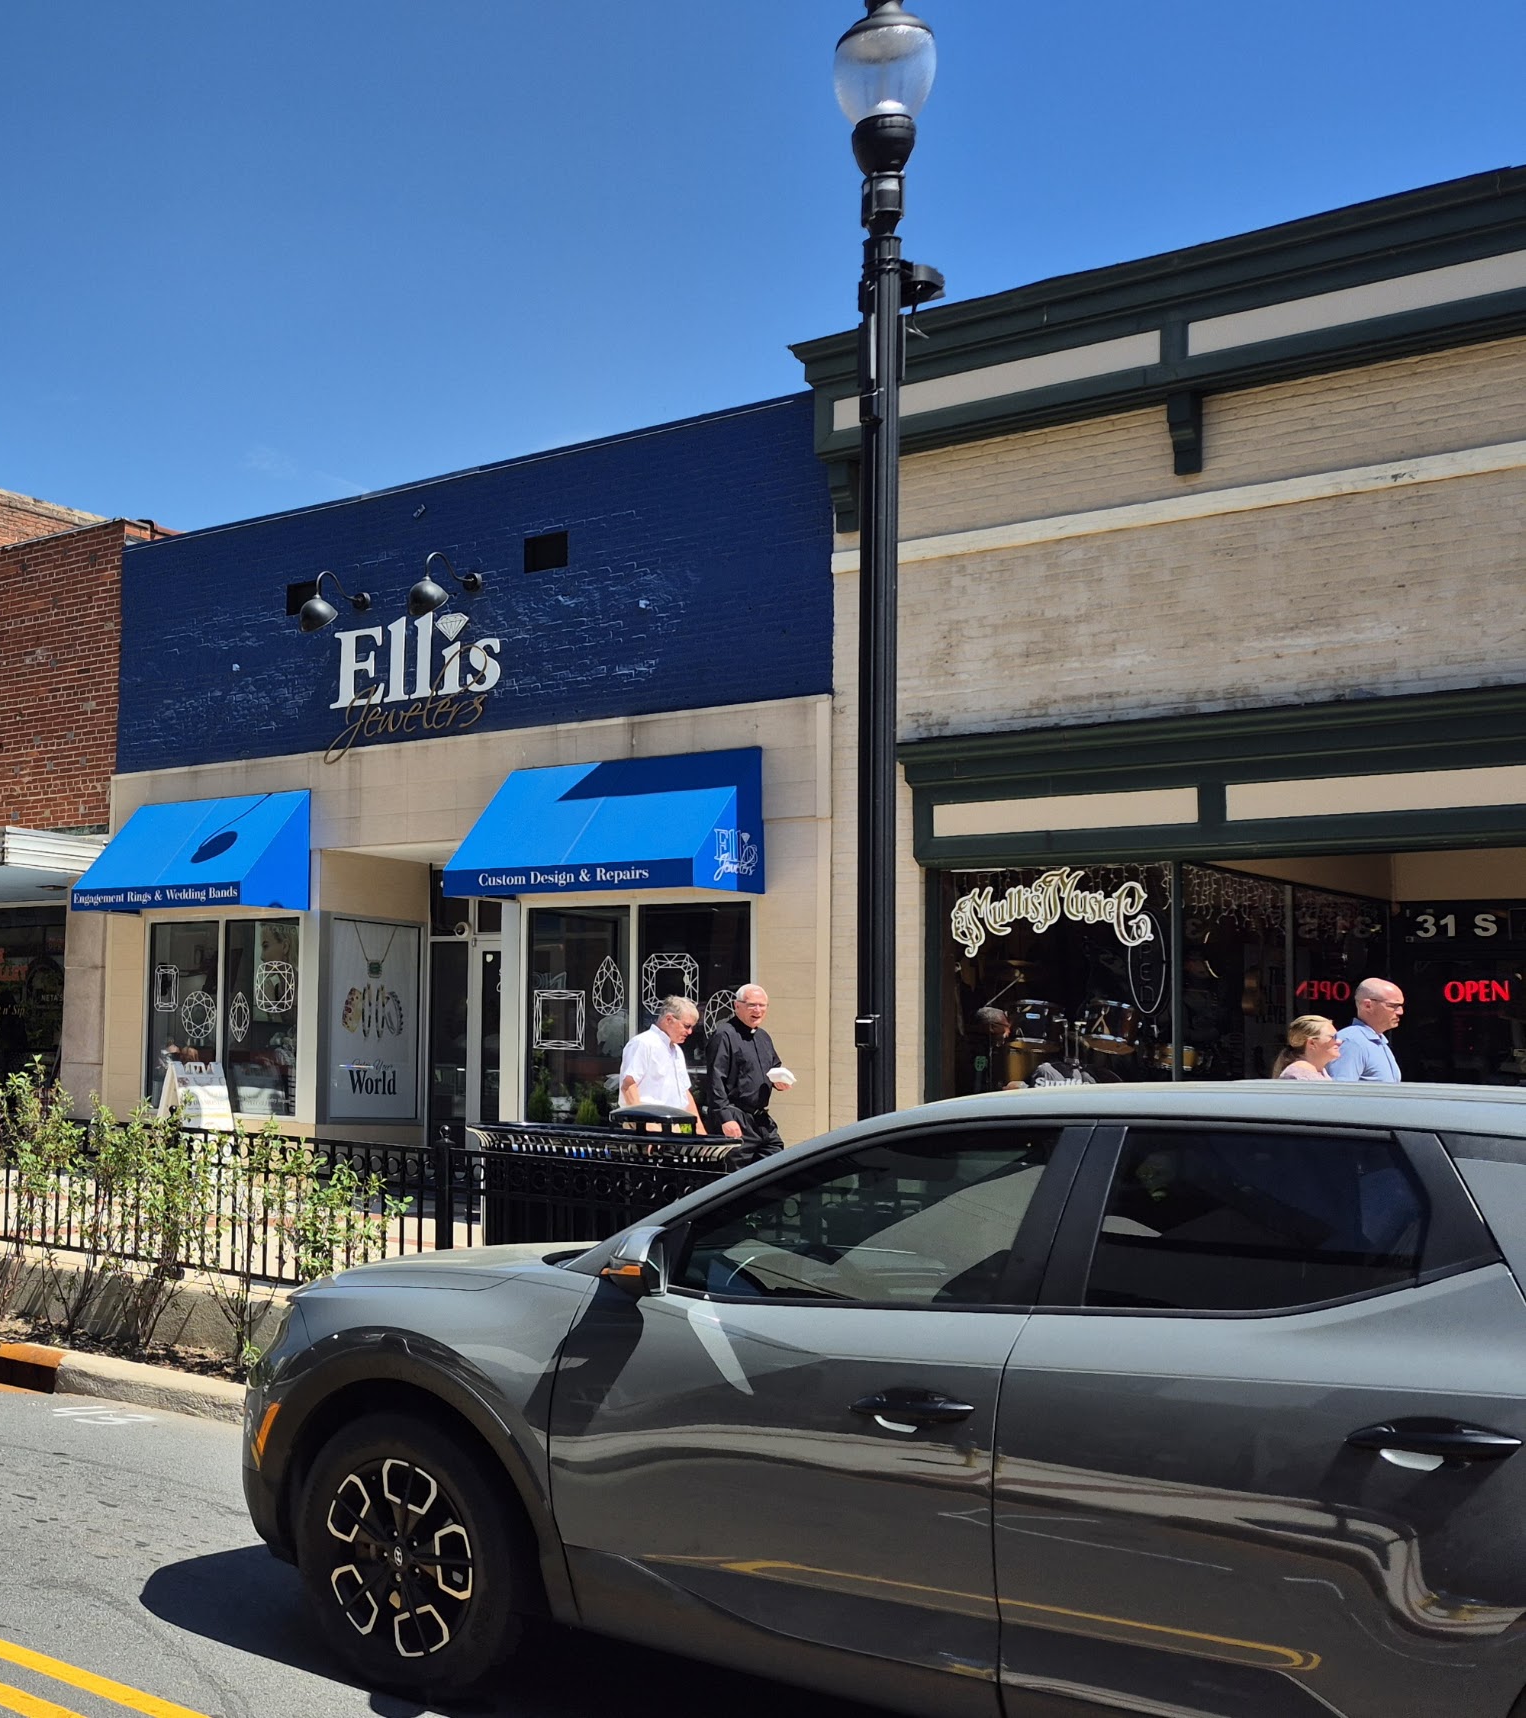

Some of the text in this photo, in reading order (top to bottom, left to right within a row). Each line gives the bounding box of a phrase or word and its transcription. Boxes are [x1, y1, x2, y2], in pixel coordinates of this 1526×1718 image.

[329, 611, 501, 709] Ellis
[324, 643, 489, 765] Jewelers
[478, 866, 650, 887] Custom Design & Repairs
[73, 886, 238, 906] Engagement Rings & Wedding Bands
[951, 885, 1042, 958] Mullis
[1415, 913, 1498, 938] 31 S
[1443, 980, 1510, 1003] OPEN
[348, 1069, 397, 1096] World
[51, 1405, 158, 1425] 43
